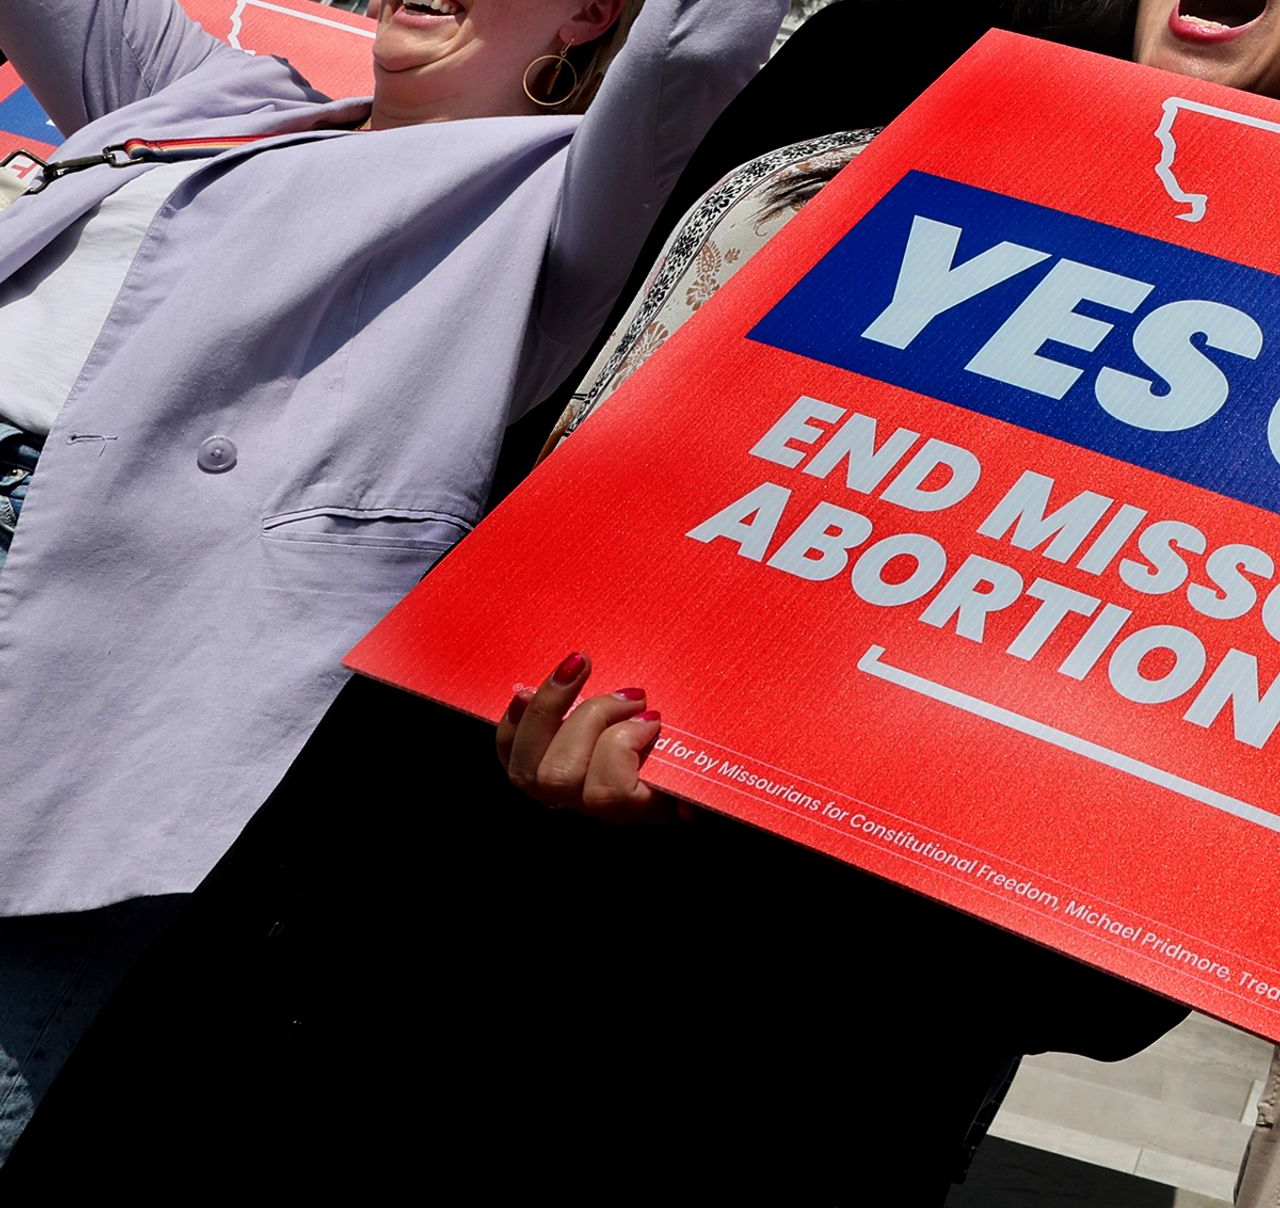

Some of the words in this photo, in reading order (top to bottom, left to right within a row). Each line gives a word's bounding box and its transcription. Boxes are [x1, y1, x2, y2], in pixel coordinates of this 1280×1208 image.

[861, 215, 1264, 433] YES
[748, 397, 980, 514] END
[667, 739, 695, 760] for
[693, 743, 719, 773] by
[718, 759, 821, 812] Missourians
[821, 799, 849, 823] for
[850, 813, 979, 877] Constitutional
[975, 864, 1060, 913] Freedom,
[1064, 899, 1143, 943] Michael
[1141, 932, 1232, 983] Pridmore,
